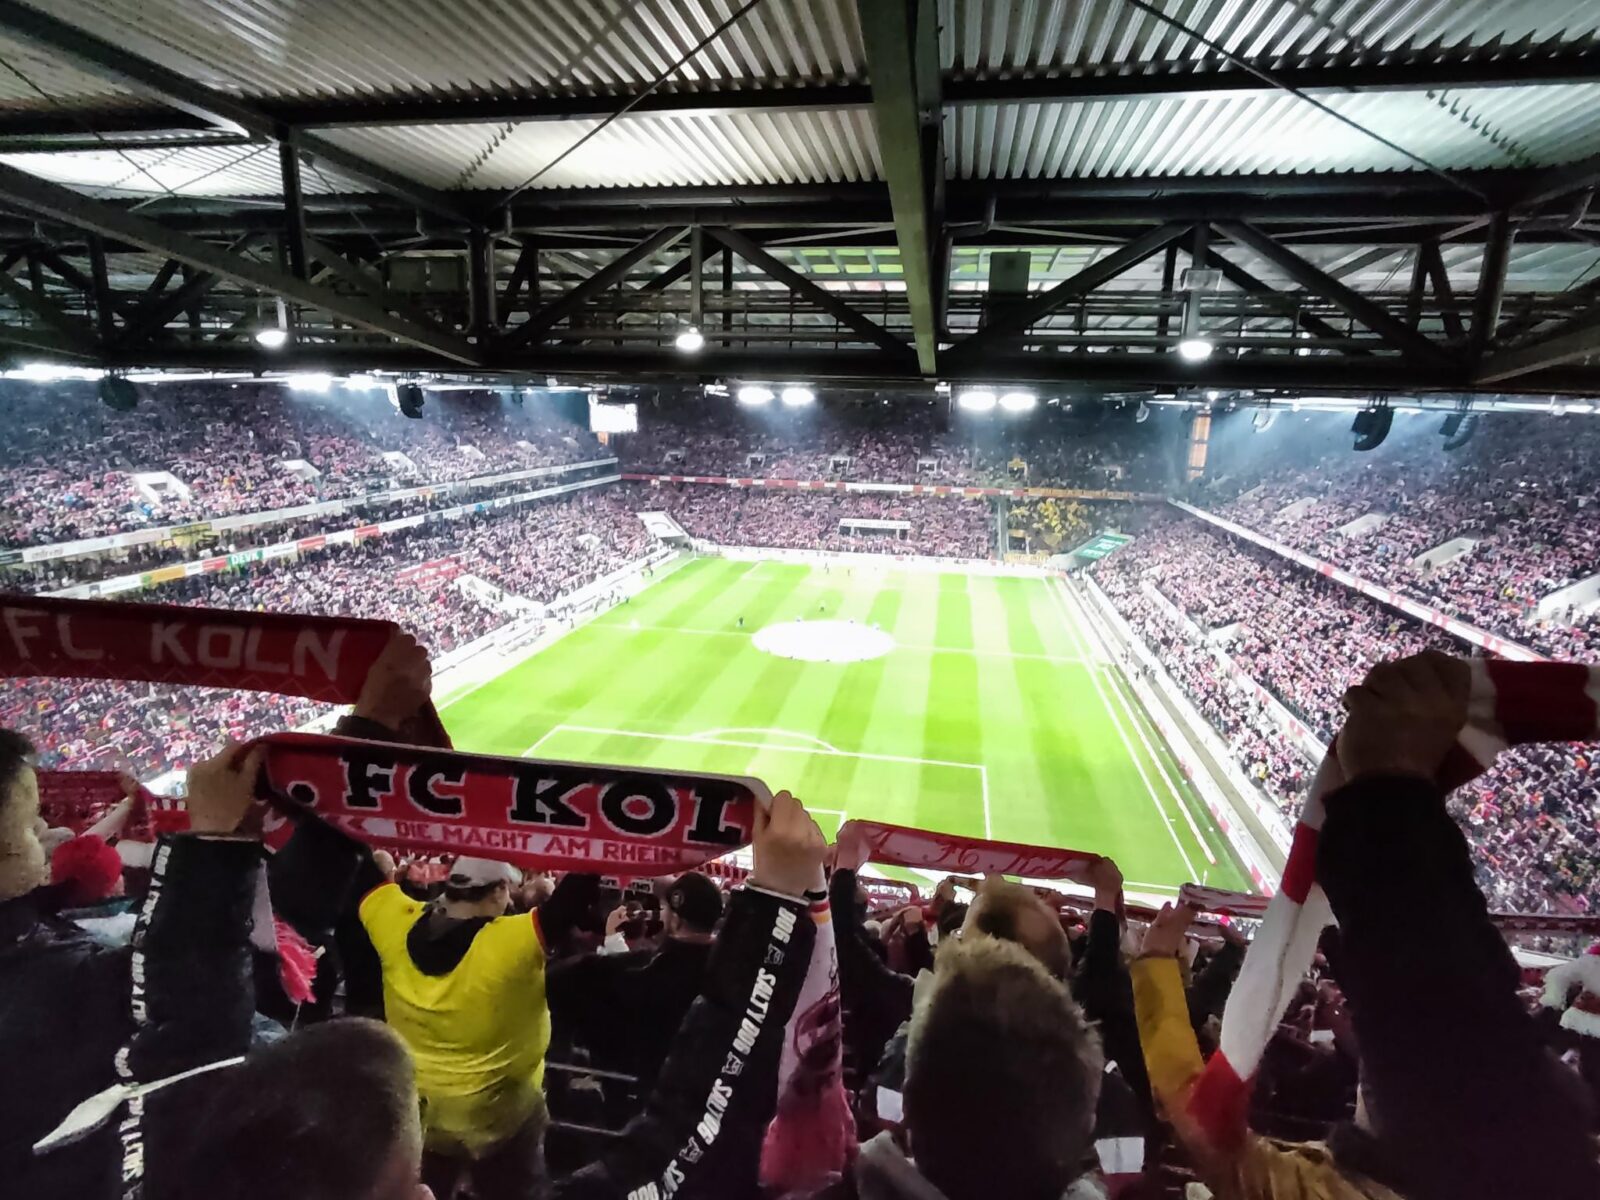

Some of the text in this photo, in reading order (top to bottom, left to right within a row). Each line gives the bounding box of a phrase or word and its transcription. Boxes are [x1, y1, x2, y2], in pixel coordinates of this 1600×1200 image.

[339, 755, 467, 819] FC
[394, 820, 681, 864] DIE MACHT AM RHEIN
[732, 967, 777, 1056] SALTY DOG
